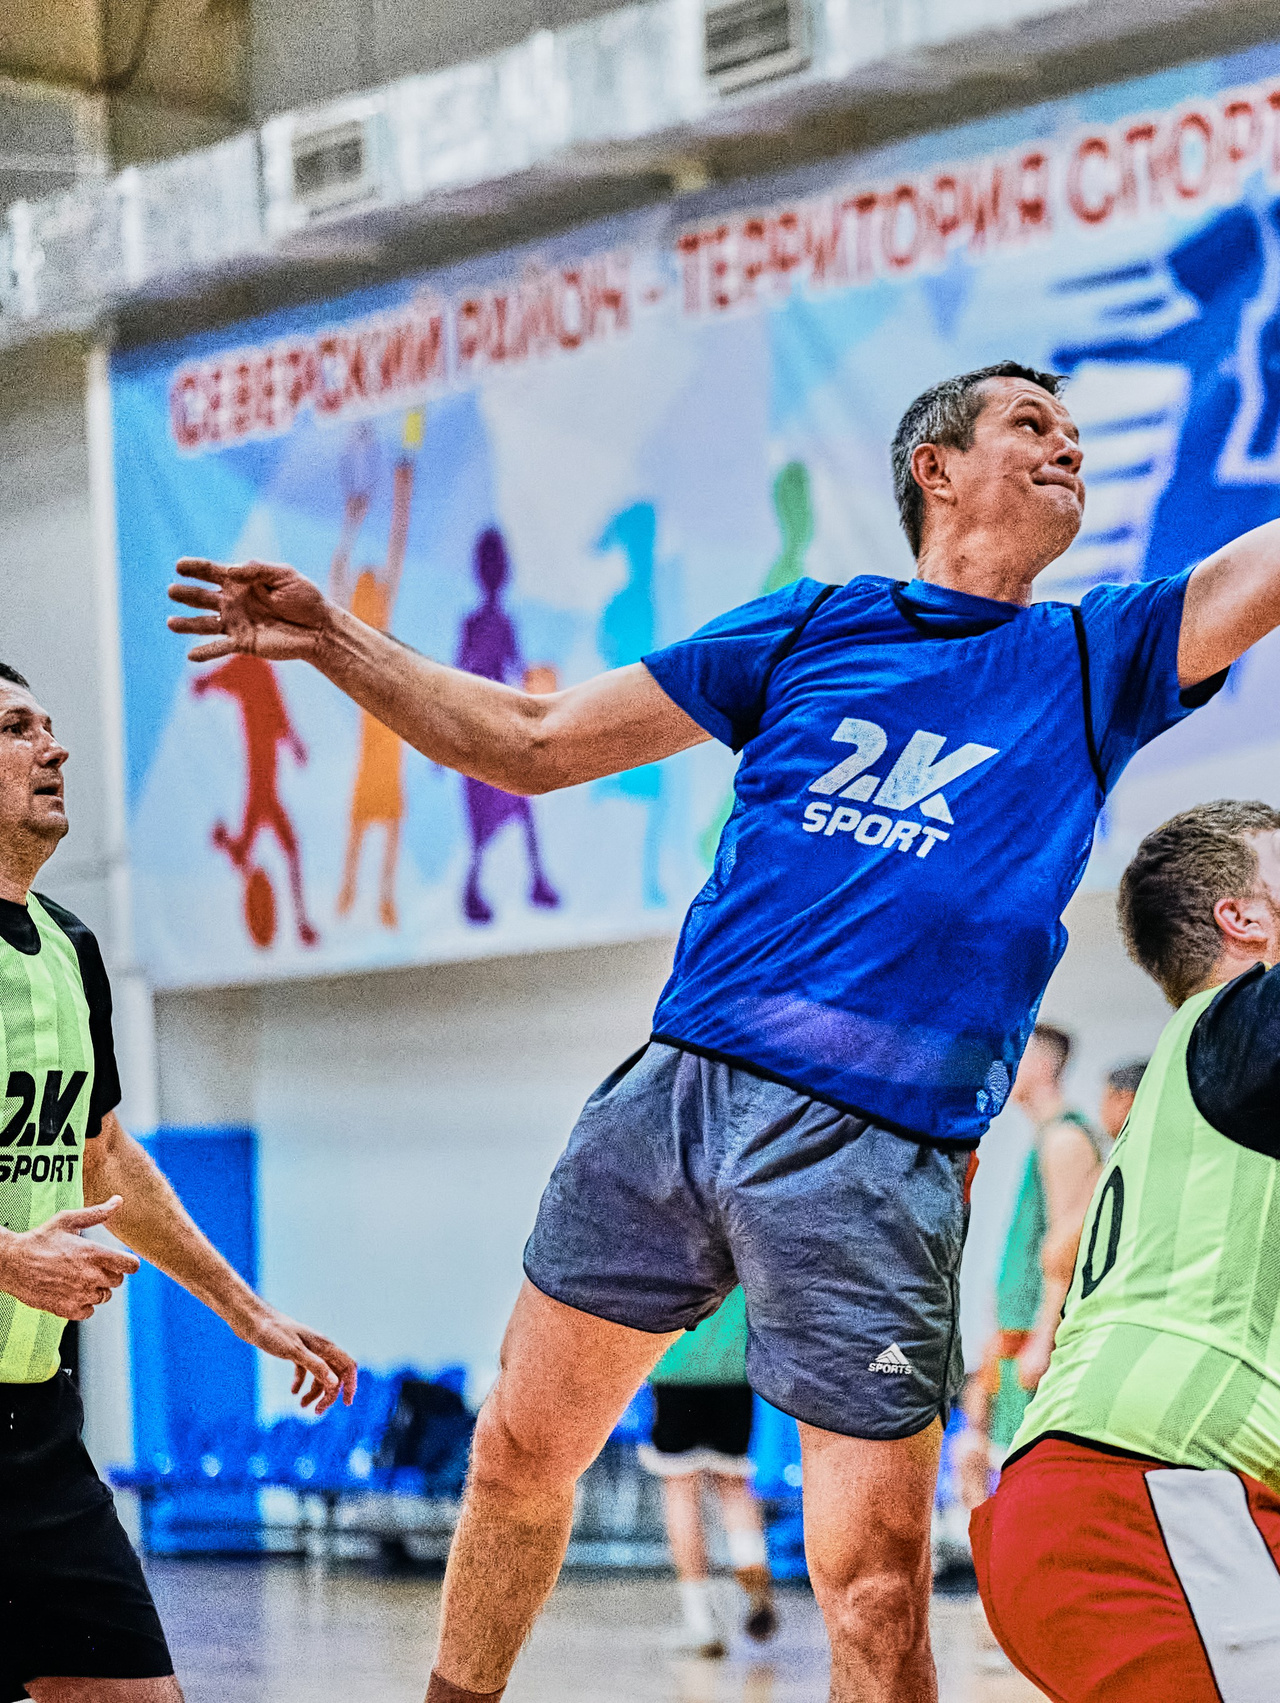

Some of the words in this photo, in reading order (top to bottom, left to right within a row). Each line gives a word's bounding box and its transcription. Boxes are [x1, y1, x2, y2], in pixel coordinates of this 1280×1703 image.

[170, 286, 445, 448] СЕВЕРСКИЙ
[456, 252, 631, 370] РАЙОН
[676, 150, 1052, 315] ТЕРРИТОРИЯ
[808, 717, 1000, 825] 2K
[802, 801, 950, 858] SPORT
[0, 1070, 89, 1147] 2K
[868, 1362, 913, 1374] SPORTS
